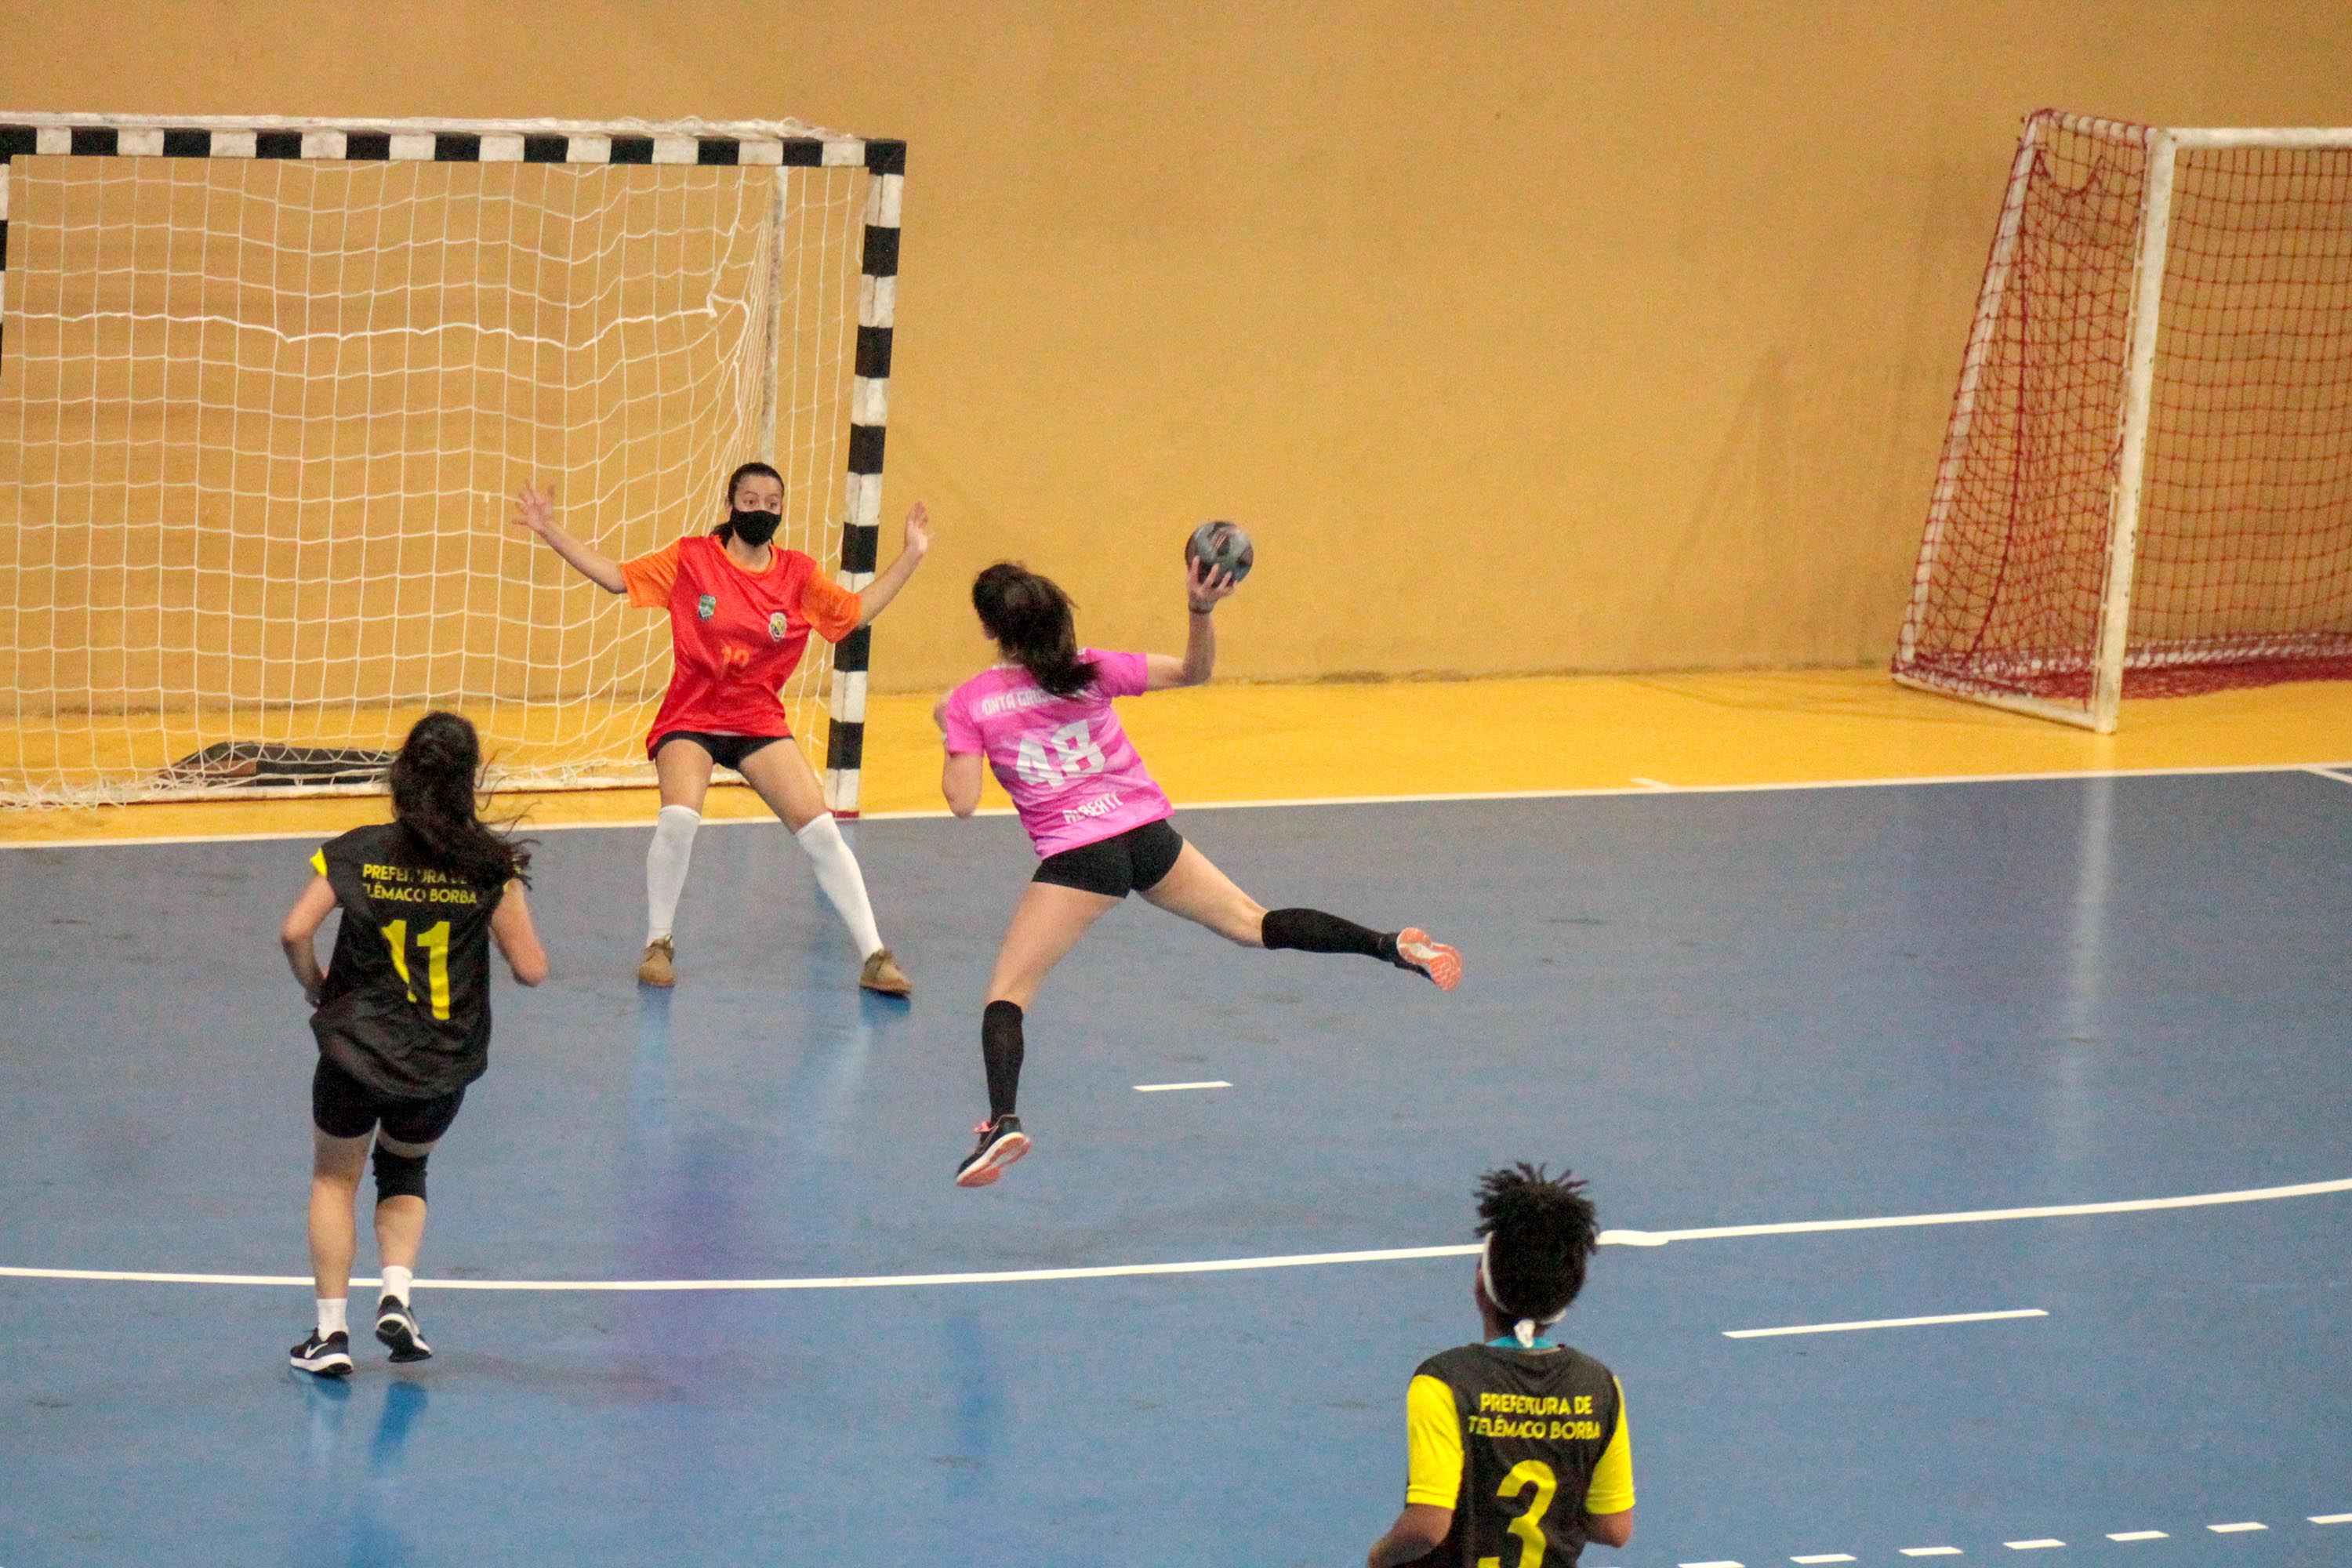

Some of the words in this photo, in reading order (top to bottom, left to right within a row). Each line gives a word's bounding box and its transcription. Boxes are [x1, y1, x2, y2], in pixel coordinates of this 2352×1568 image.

[1016, 719, 1105, 789] 48
[429, 887, 477, 904] BORBA
[381, 919, 451, 1020] 11
[1573, 1395, 1593, 1414] DE
[1549, 1420, 1601, 1439] BORBA
[1476, 1459, 1558, 1568] 3
